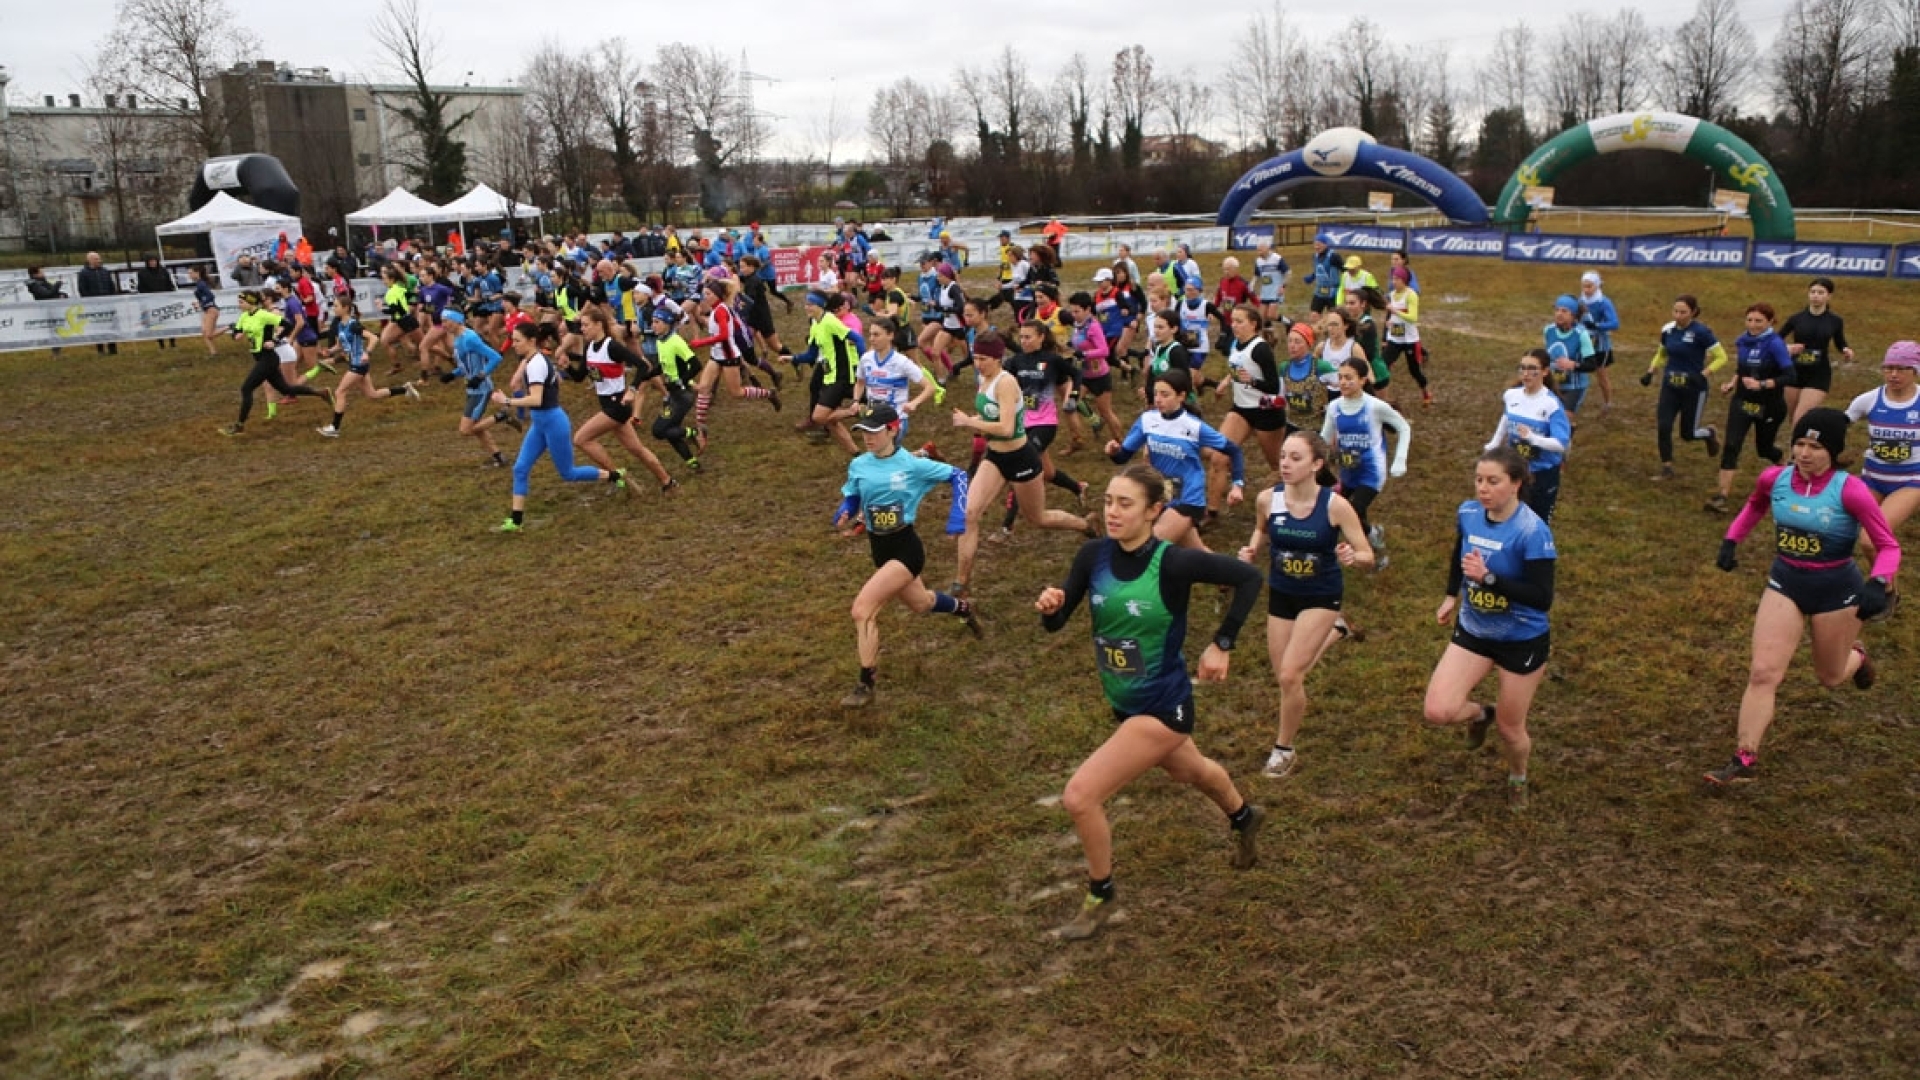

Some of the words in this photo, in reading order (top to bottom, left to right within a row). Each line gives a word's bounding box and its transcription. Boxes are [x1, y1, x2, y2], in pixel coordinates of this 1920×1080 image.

[1350, 233, 1403, 249] MIZUNO
[1443, 236, 1503, 251] MIZUNO
[1545, 244, 1617, 261] MIZUNO
[1667, 246, 1743, 263] MIZUNO
[1797, 252, 1886, 271] MIZUNO
[872, 512, 897, 526] 209
[1777, 532, 1822, 554] 2493
[1282, 559, 1314, 573] 302
